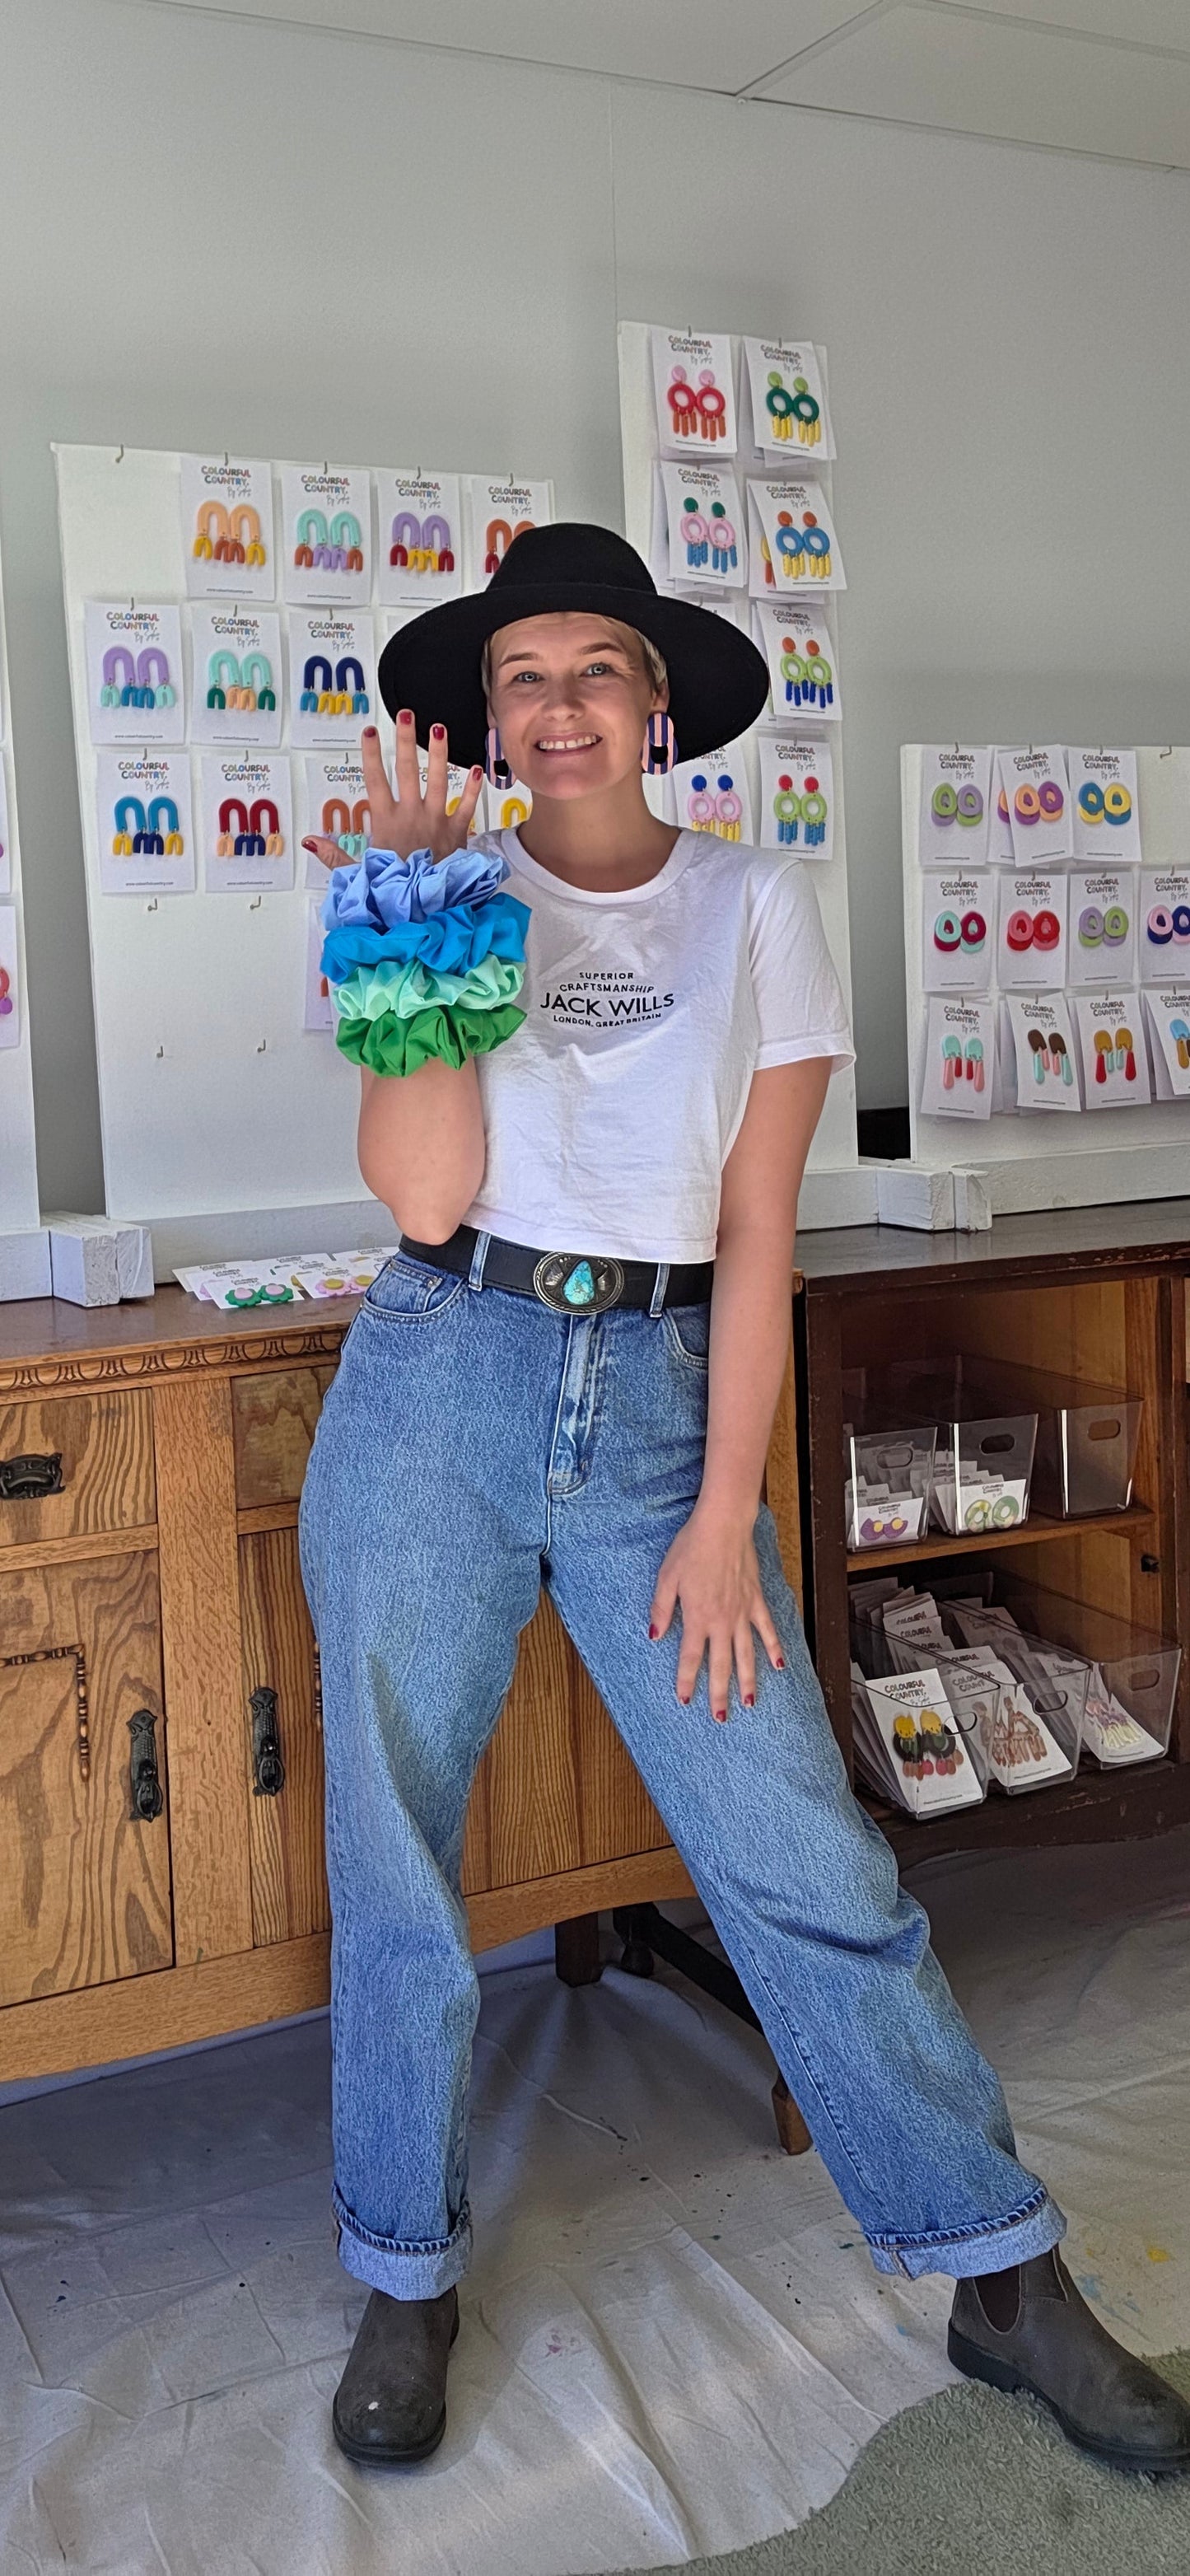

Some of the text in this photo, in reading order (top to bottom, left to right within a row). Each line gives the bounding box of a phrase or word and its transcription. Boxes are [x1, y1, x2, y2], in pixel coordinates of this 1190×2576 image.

[669, 335, 712, 348] COLOURFUL
[761, 344, 801, 358] COLOURFUL
[201, 465, 251, 478] COLOURFUL
[678, 469, 720, 481] COLOURFUL
[301, 475, 350, 486] COLOURFUL
[395, 479, 441, 490] COLOURFUL
[488, 486, 532, 497] COLOURFUL
[106, 612, 160, 621] COLOURFUL
[212, 617, 259, 628] COLOURFUL
[308, 621, 354, 631] COLOURFUL
[775, 745, 815, 754] COLOURFUL
[939, 754, 975, 762] COLOURFUL
[1014, 753, 1048, 764] COLOURFUL
[1082, 754, 1120, 763] COLOURFUL
[118, 762, 170, 771] COLOURFUL
[222, 764, 270, 773] COLOURFUL
[324, 765, 363, 774] COLOURFU
[579, 972, 634, 980] SUPERIOR
[559, 982, 655, 993] CRAFTSMANSHIP
[540, 993, 674, 1017] JACK WILLS
[944, 1006, 980, 1017] COLOURFUL
[595, 1019, 624, 1028] GREAT
[626, 1012, 661, 1024] BRITAIN
[884, 1680, 926, 1694] COLOURFUL
